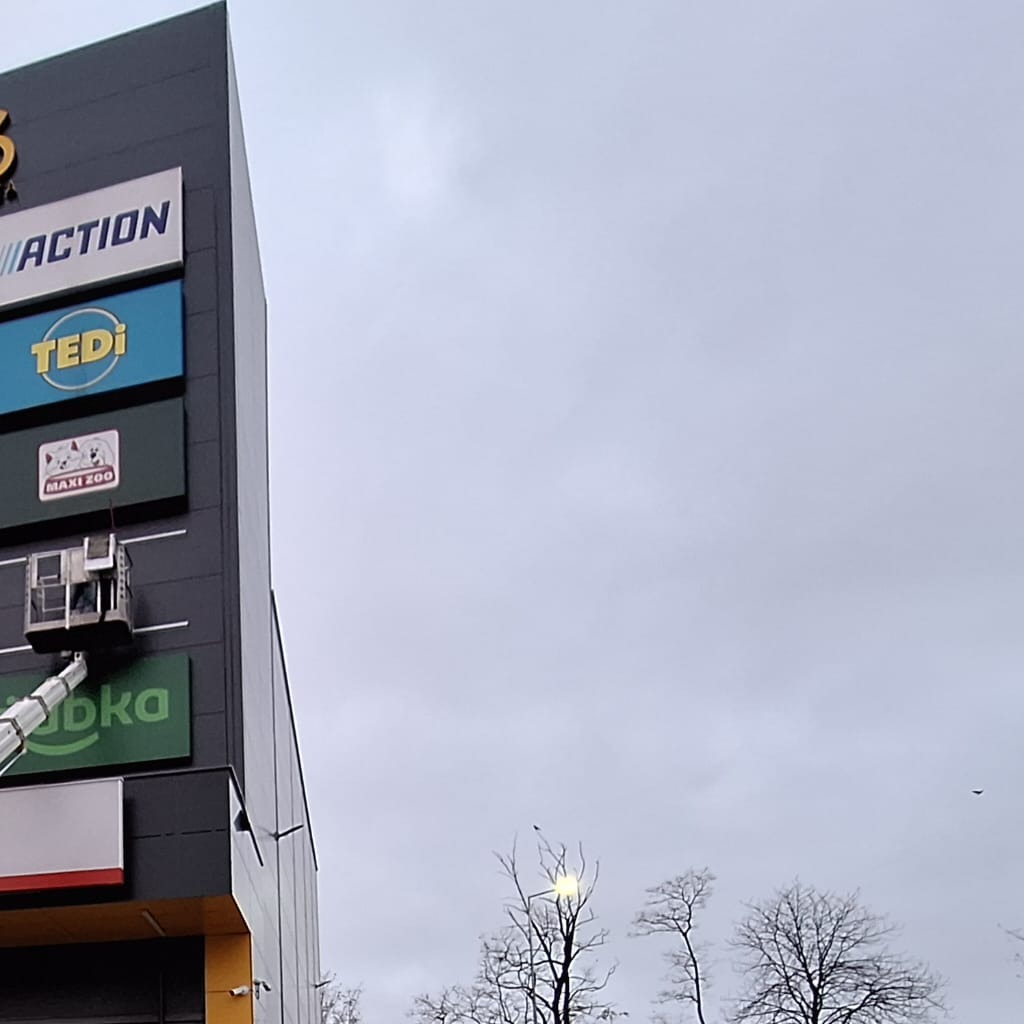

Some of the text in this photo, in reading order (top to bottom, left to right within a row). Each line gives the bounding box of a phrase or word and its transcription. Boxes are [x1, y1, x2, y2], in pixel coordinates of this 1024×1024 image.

[15, 200, 171, 272] ACTION
[31, 323, 127, 374] TEDi
[46, 471, 114, 493] MAXI ZOO
